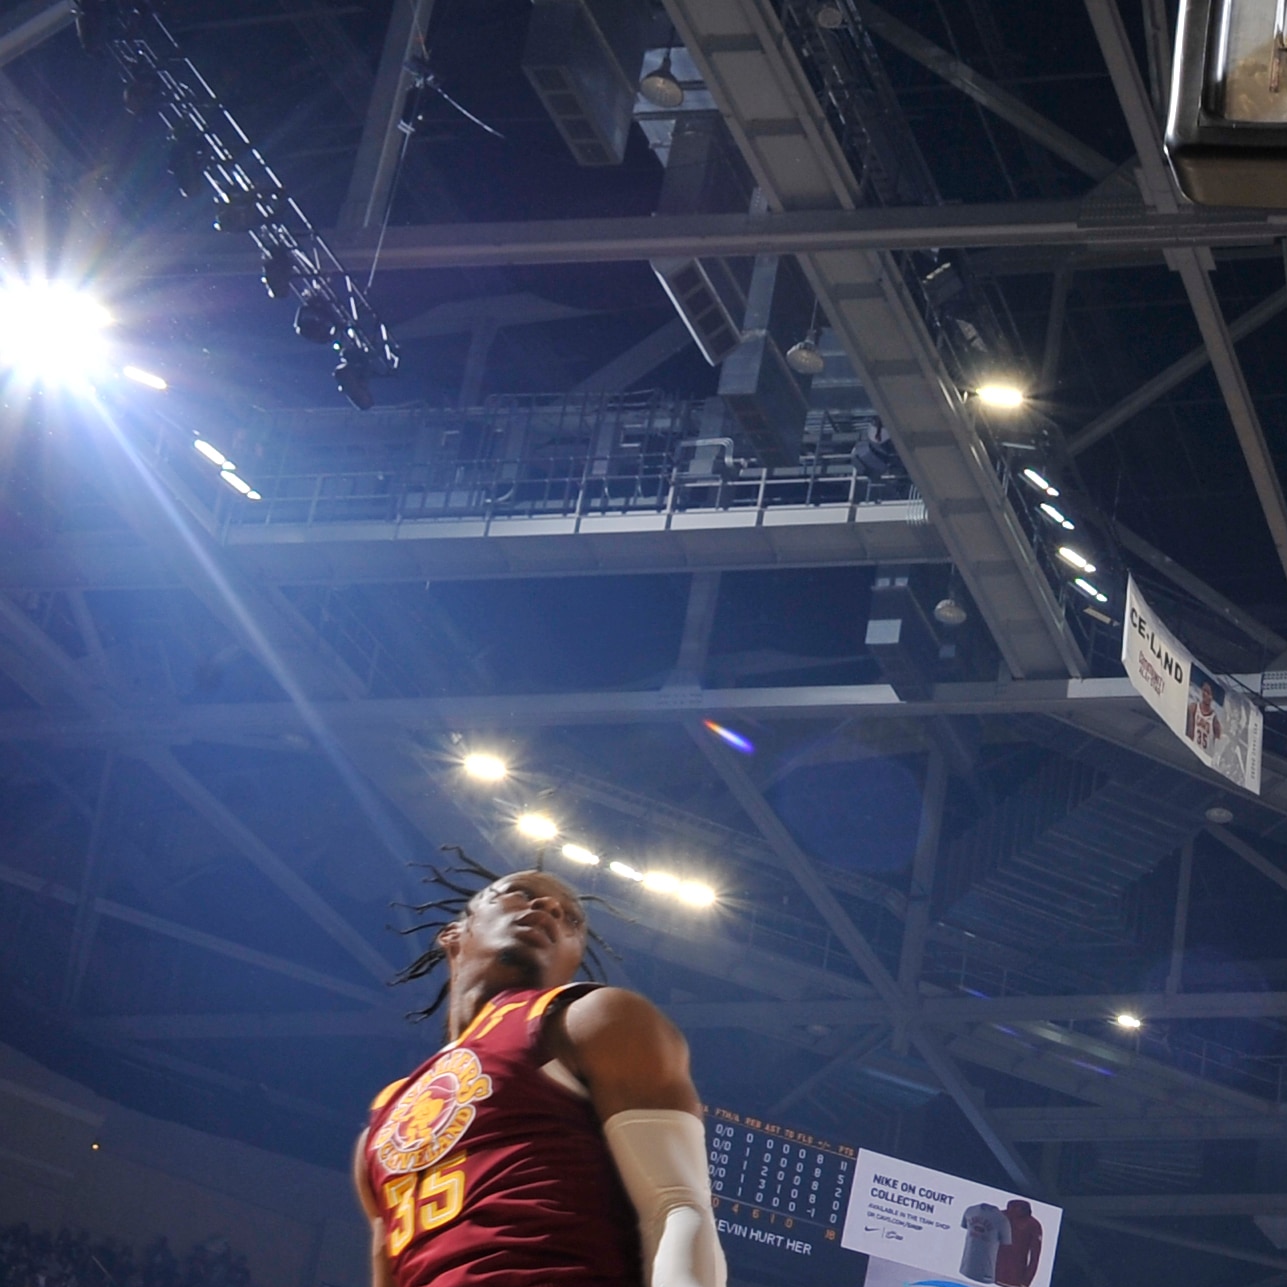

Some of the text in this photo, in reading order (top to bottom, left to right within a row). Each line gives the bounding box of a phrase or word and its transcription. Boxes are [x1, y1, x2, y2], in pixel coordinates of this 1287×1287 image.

[715, 1123, 734, 1138] 0/0
[712, 1137, 731, 1151] 0/0
[710, 1151, 729, 1165] 0/0
[872, 1173, 955, 1206] NIKE ON COURT
[870, 1187, 935, 1214] COLLECTION
[714, 1218, 813, 1256] EVIN HURT HER
